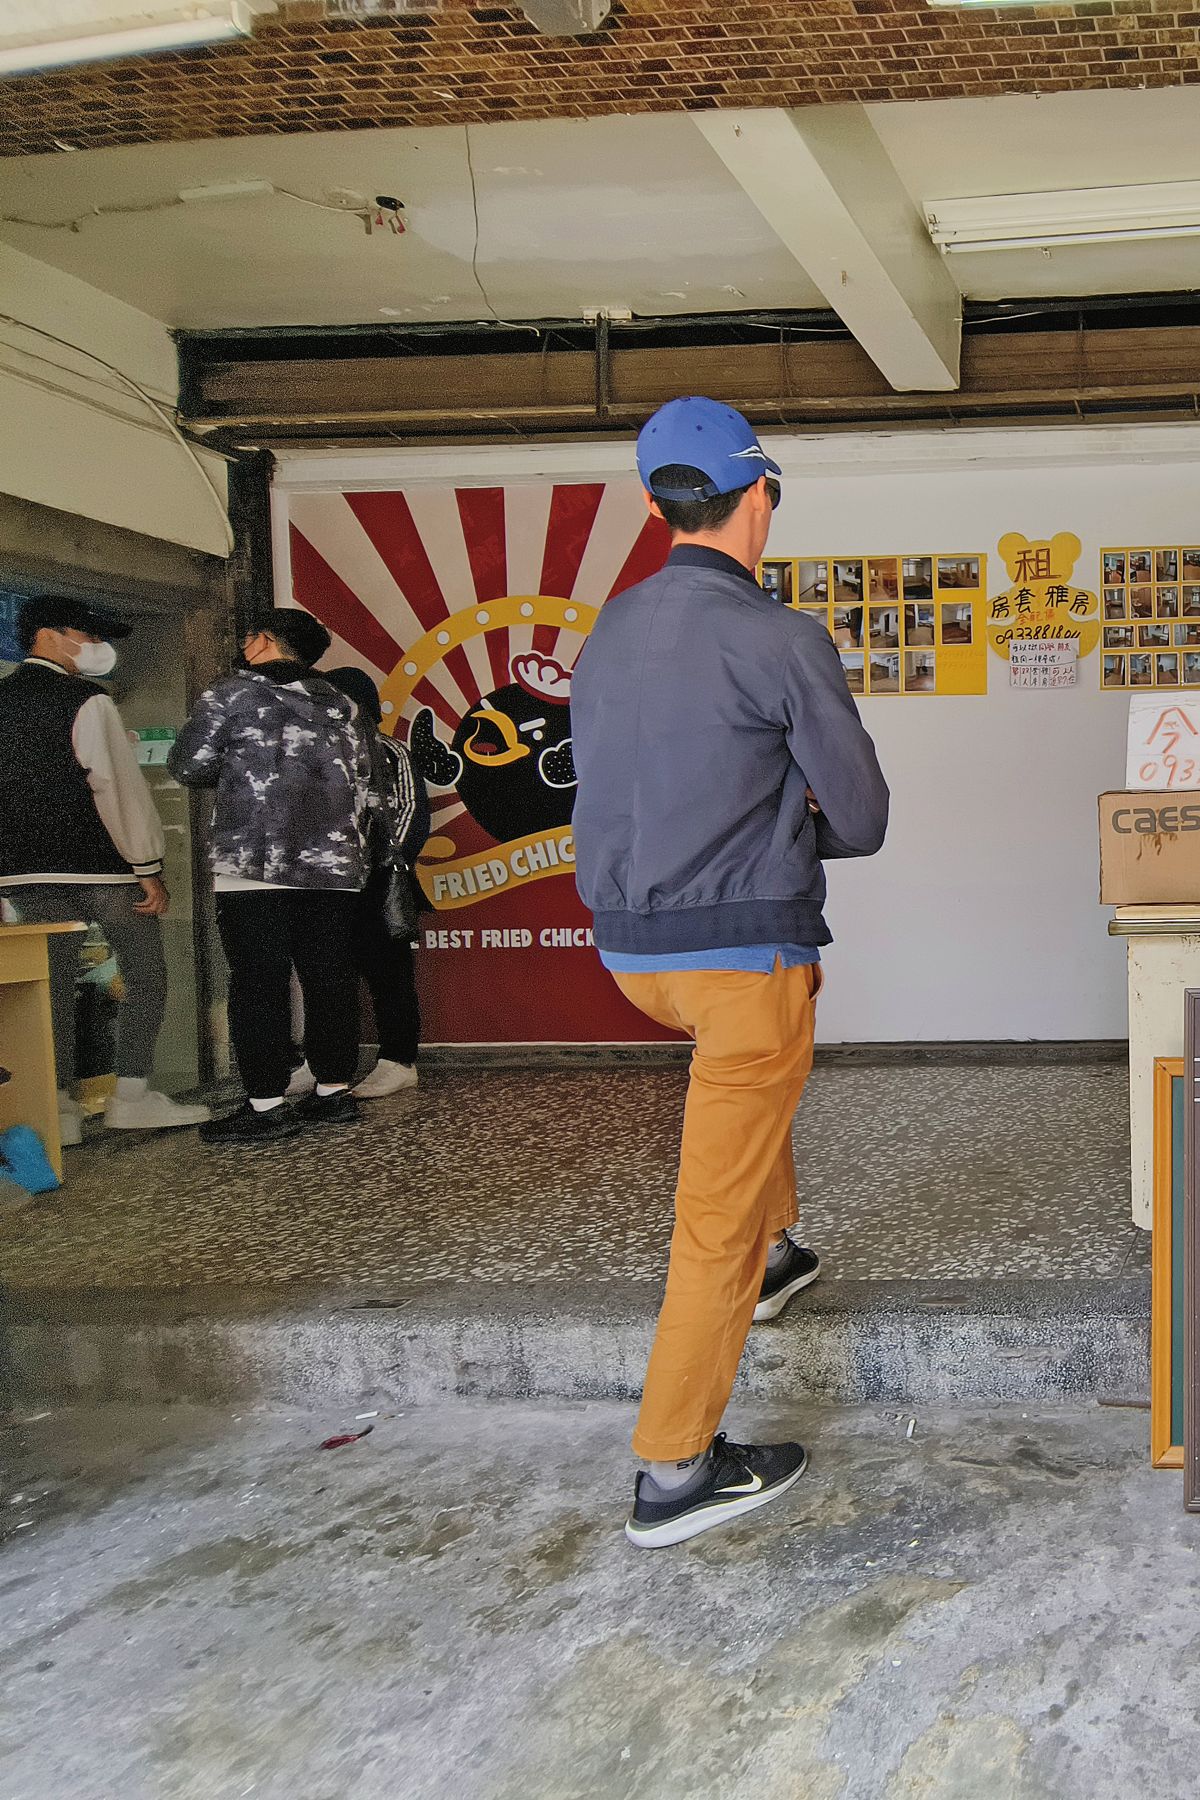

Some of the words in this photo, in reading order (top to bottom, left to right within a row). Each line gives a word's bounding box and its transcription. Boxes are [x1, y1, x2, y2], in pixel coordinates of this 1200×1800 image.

[1014, 548, 1062, 583] 租
[432, 859, 509, 901] FRIED
[425, 929, 474, 949] BEST
[481, 928, 533, 949] FRIED
